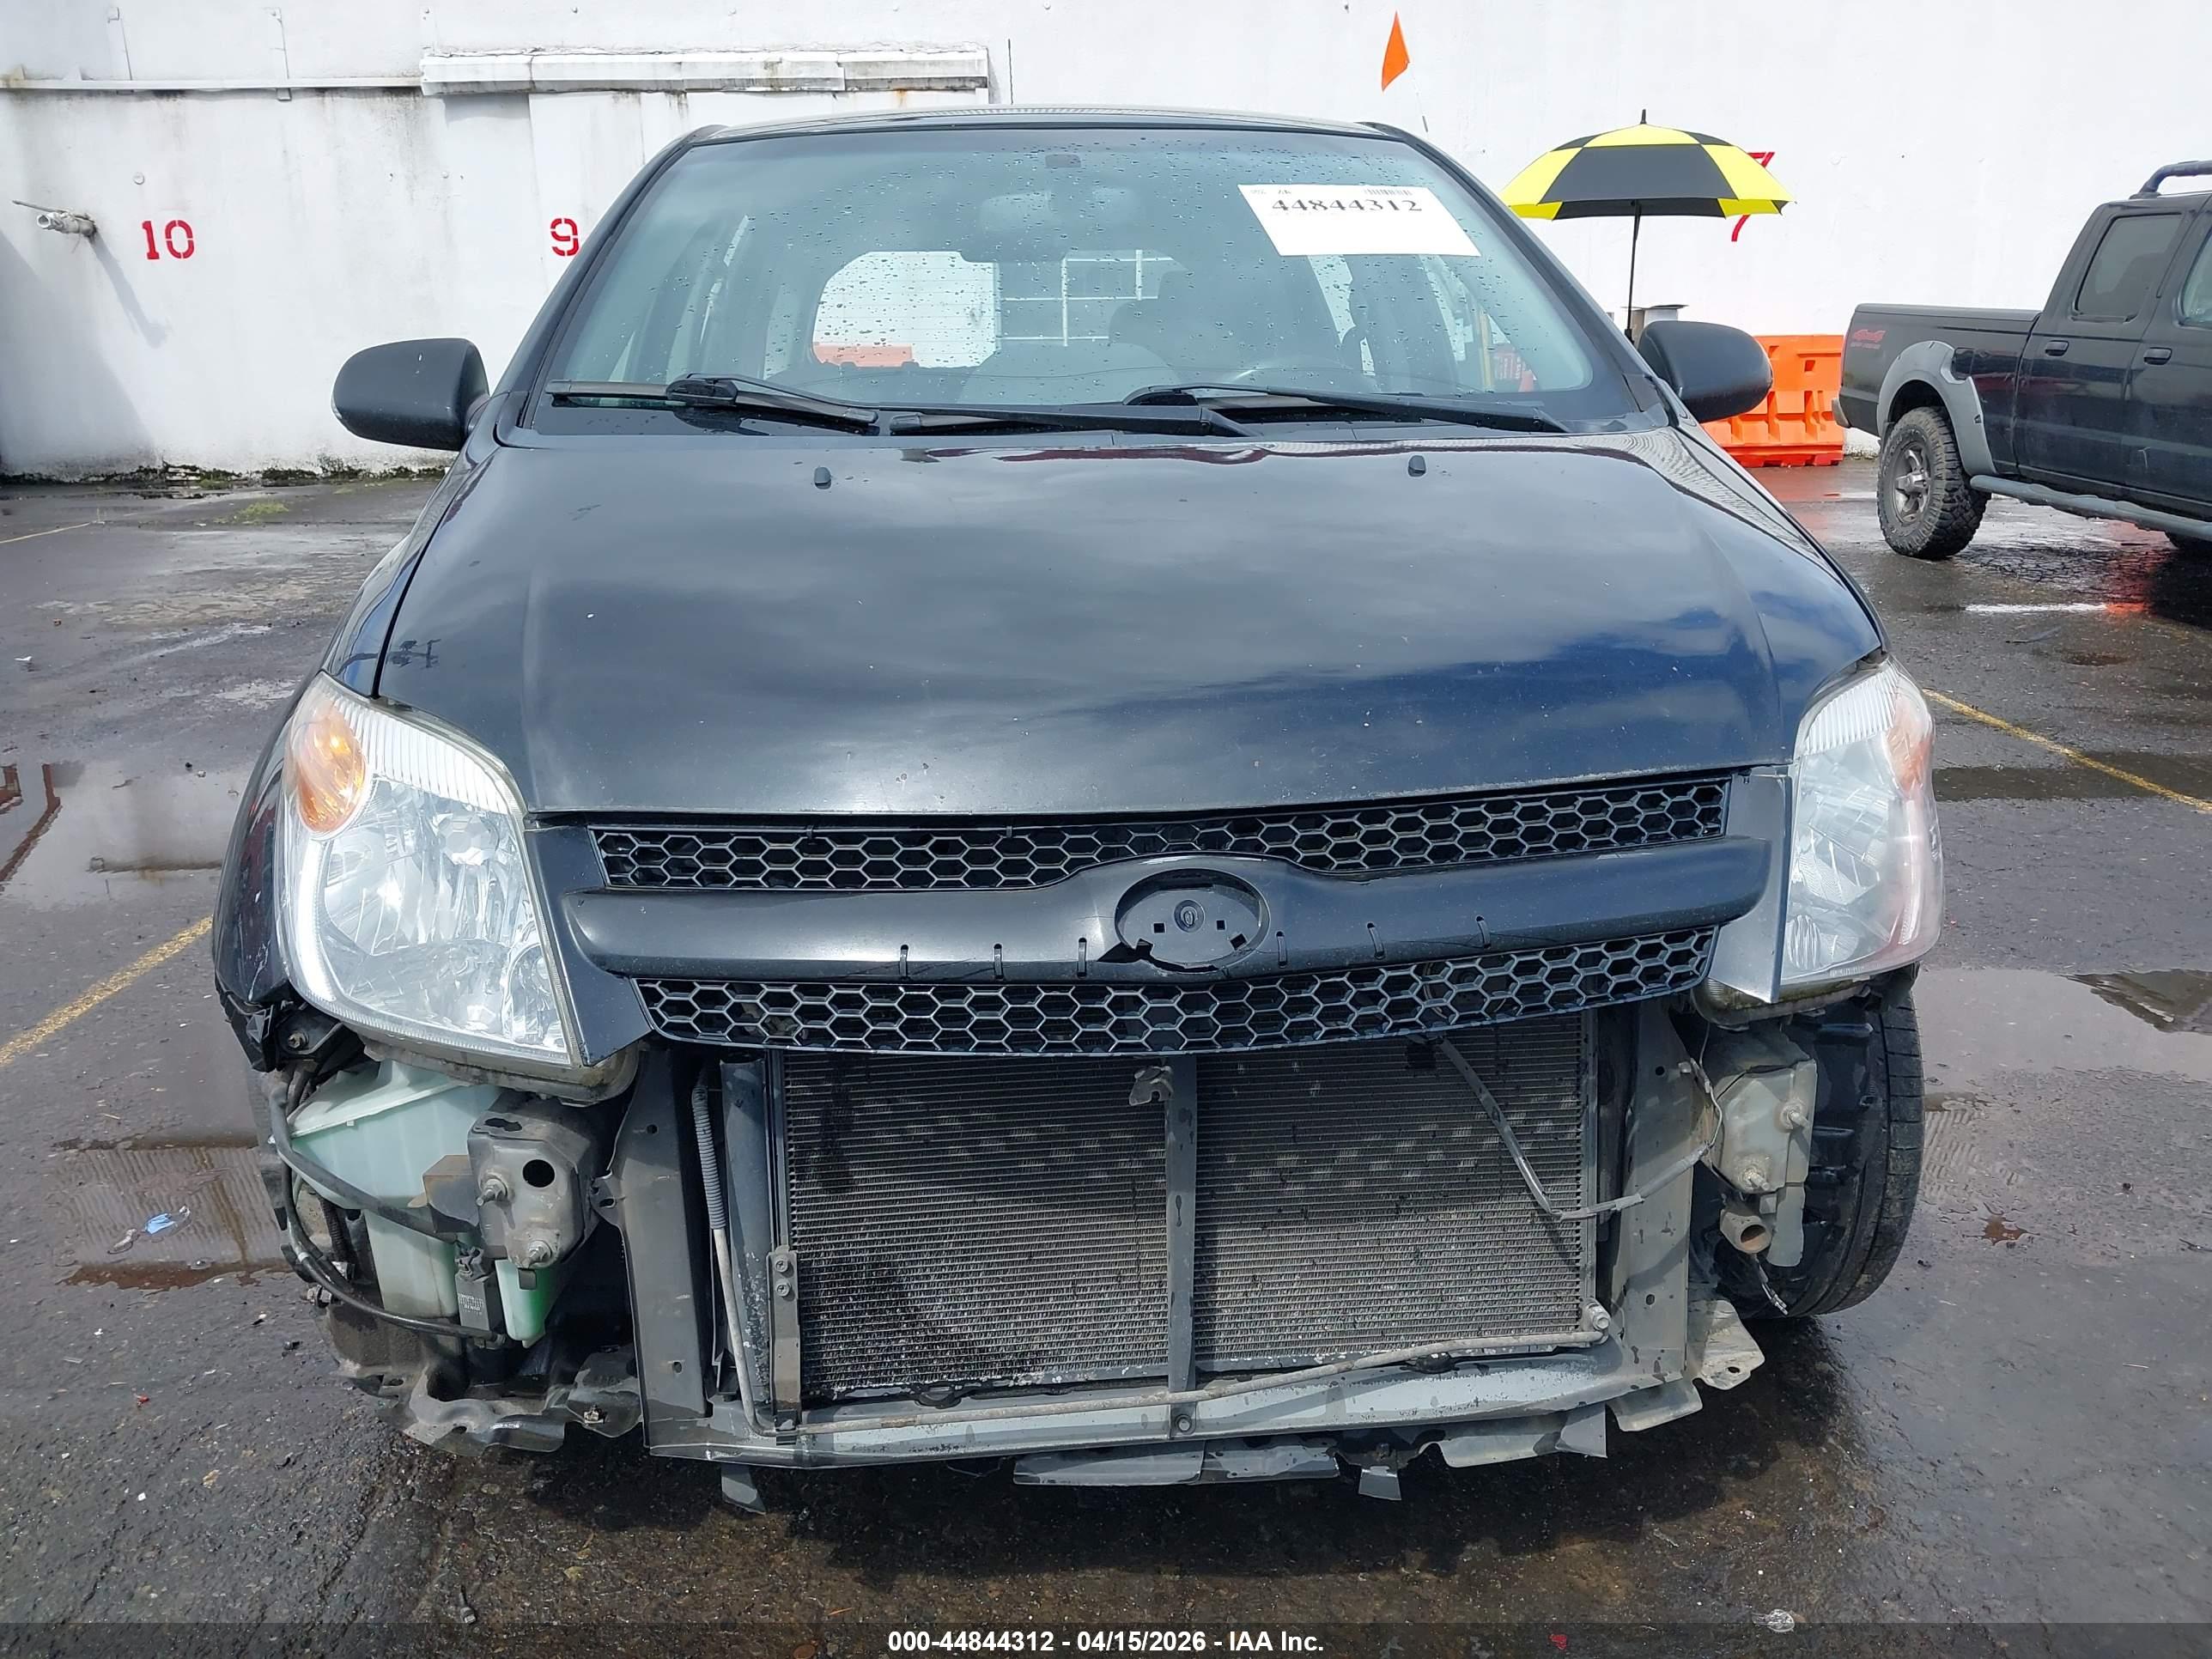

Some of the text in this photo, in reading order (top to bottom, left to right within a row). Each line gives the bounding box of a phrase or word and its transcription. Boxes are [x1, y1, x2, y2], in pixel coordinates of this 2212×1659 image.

[1272, 198, 1422, 211] 44844312
[143, 220, 195, 260] 10
[550, 218, 580, 257] 9
